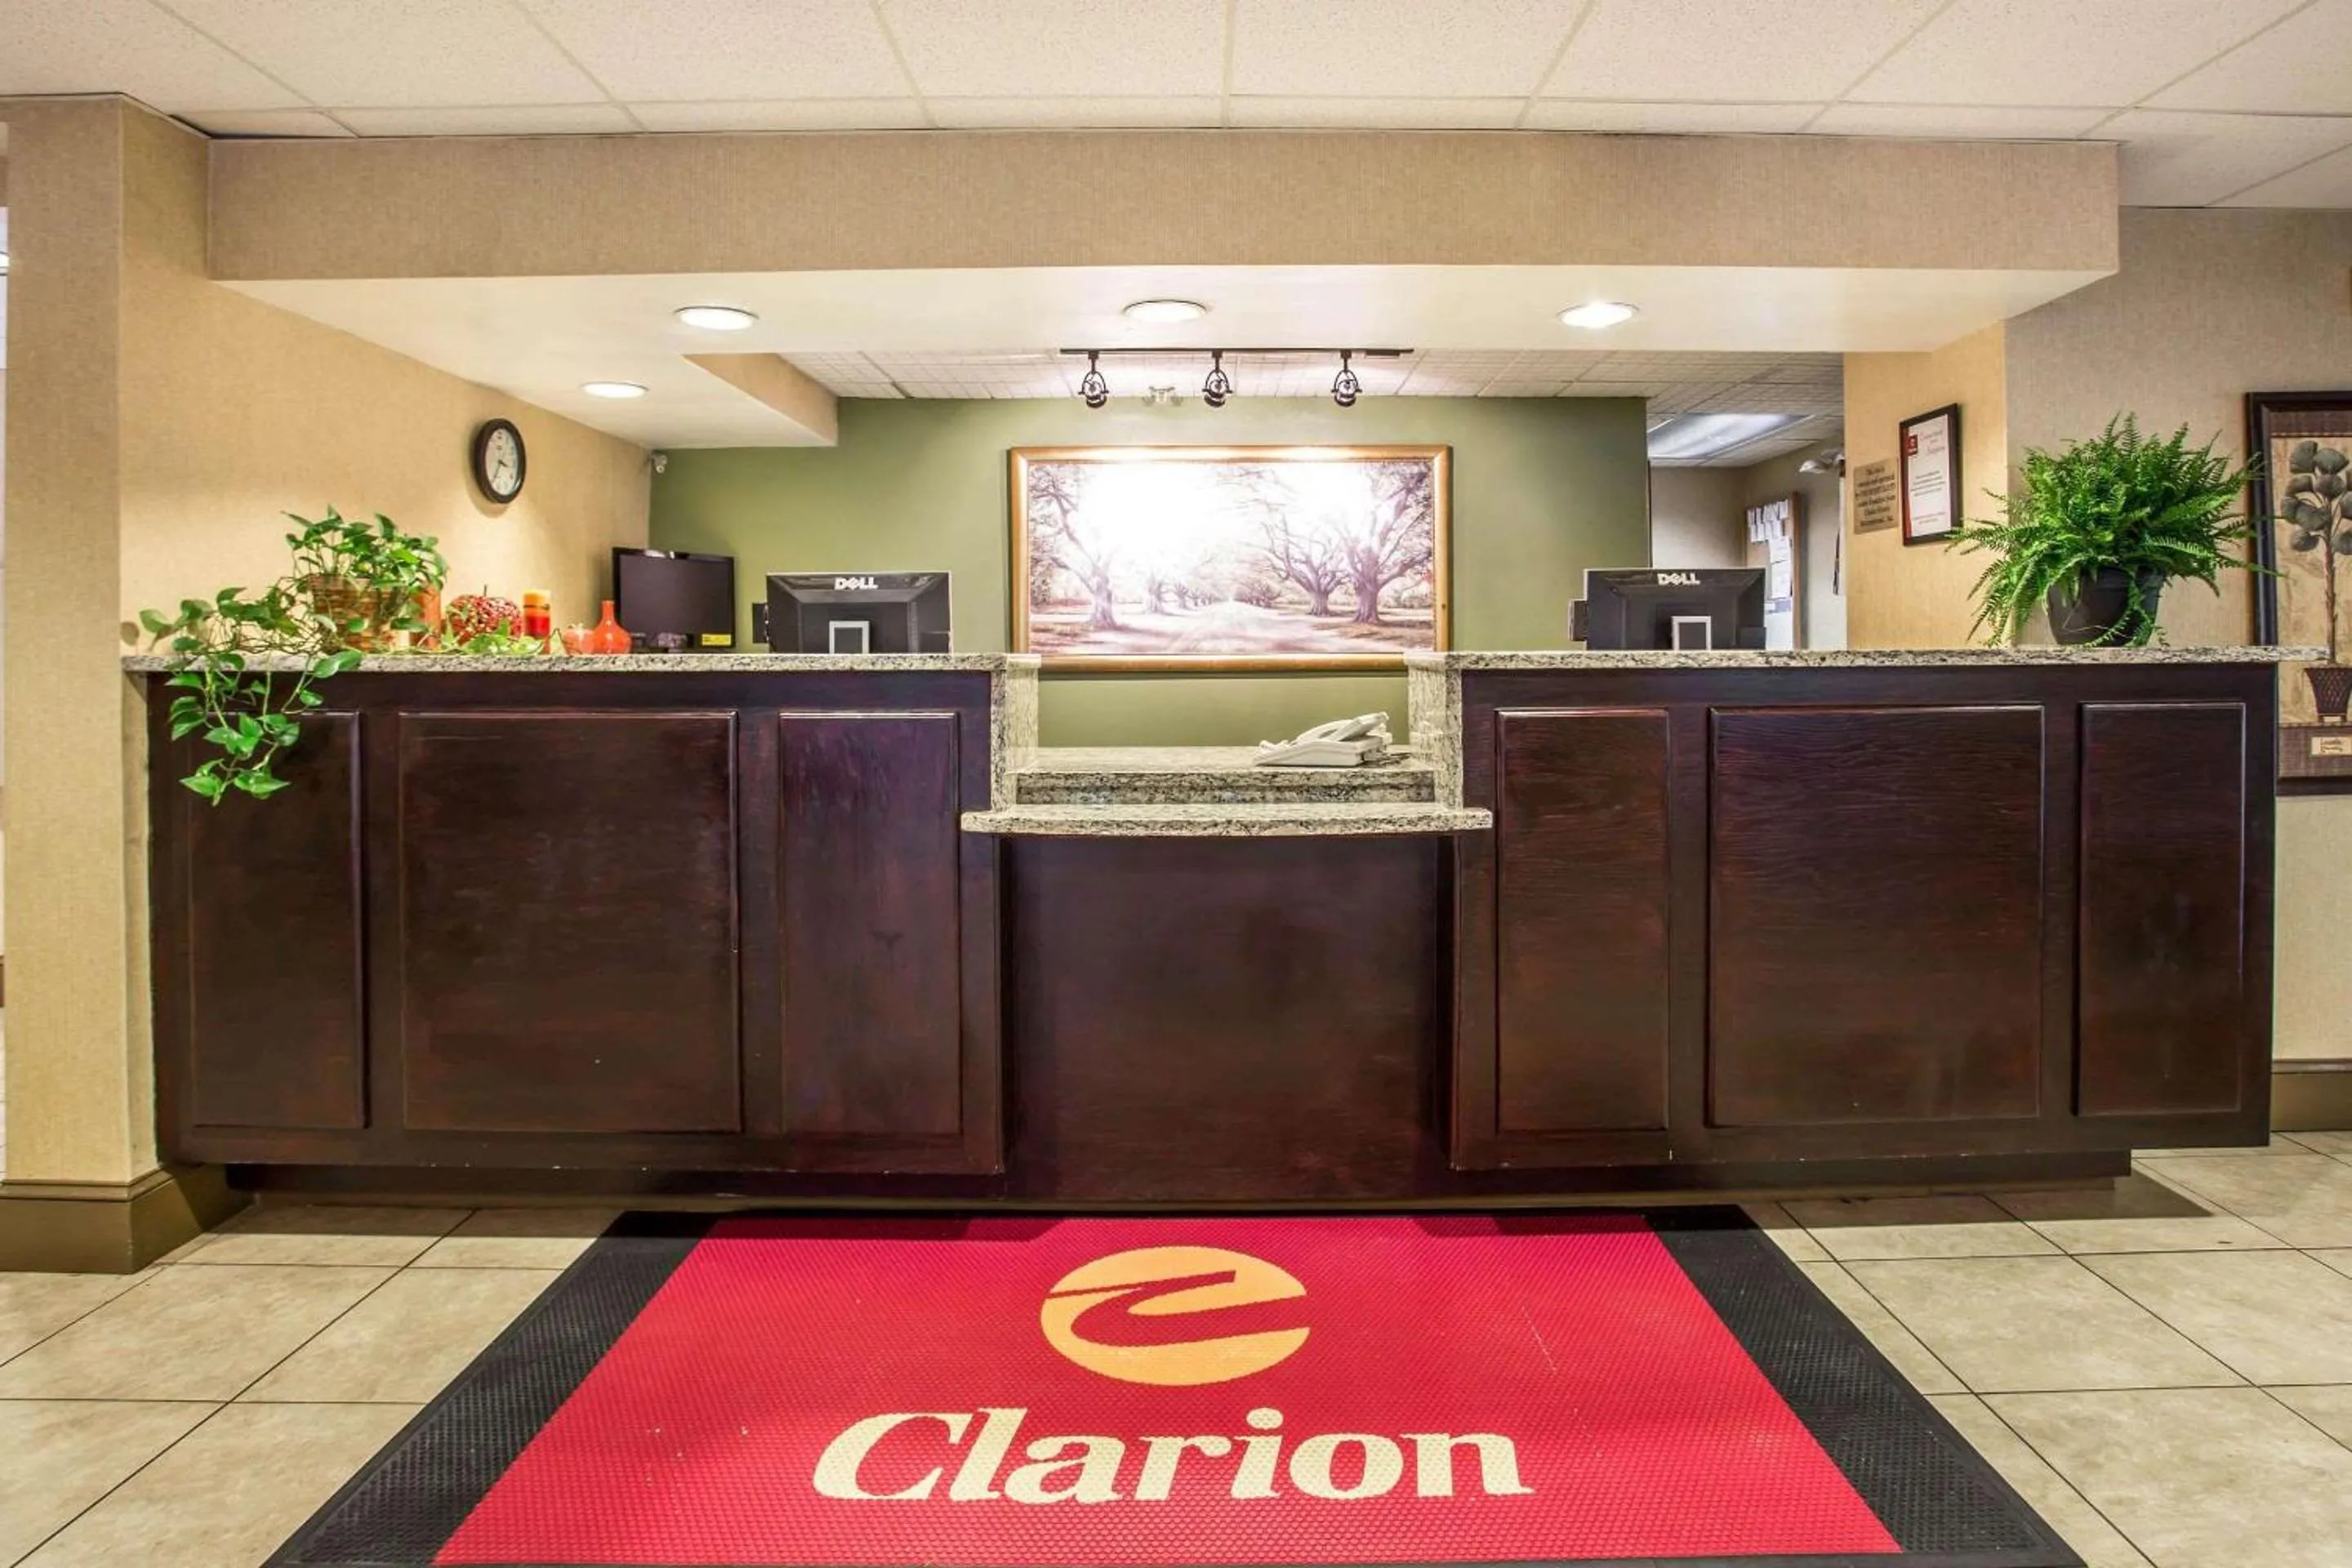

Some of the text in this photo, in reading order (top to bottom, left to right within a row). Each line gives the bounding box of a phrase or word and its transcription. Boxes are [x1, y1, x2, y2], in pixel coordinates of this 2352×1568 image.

[834, 576, 879, 590] DELL
[1657, 572, 1700, 586] DELL
[812, 1407, 1535, 1504] Clarion
